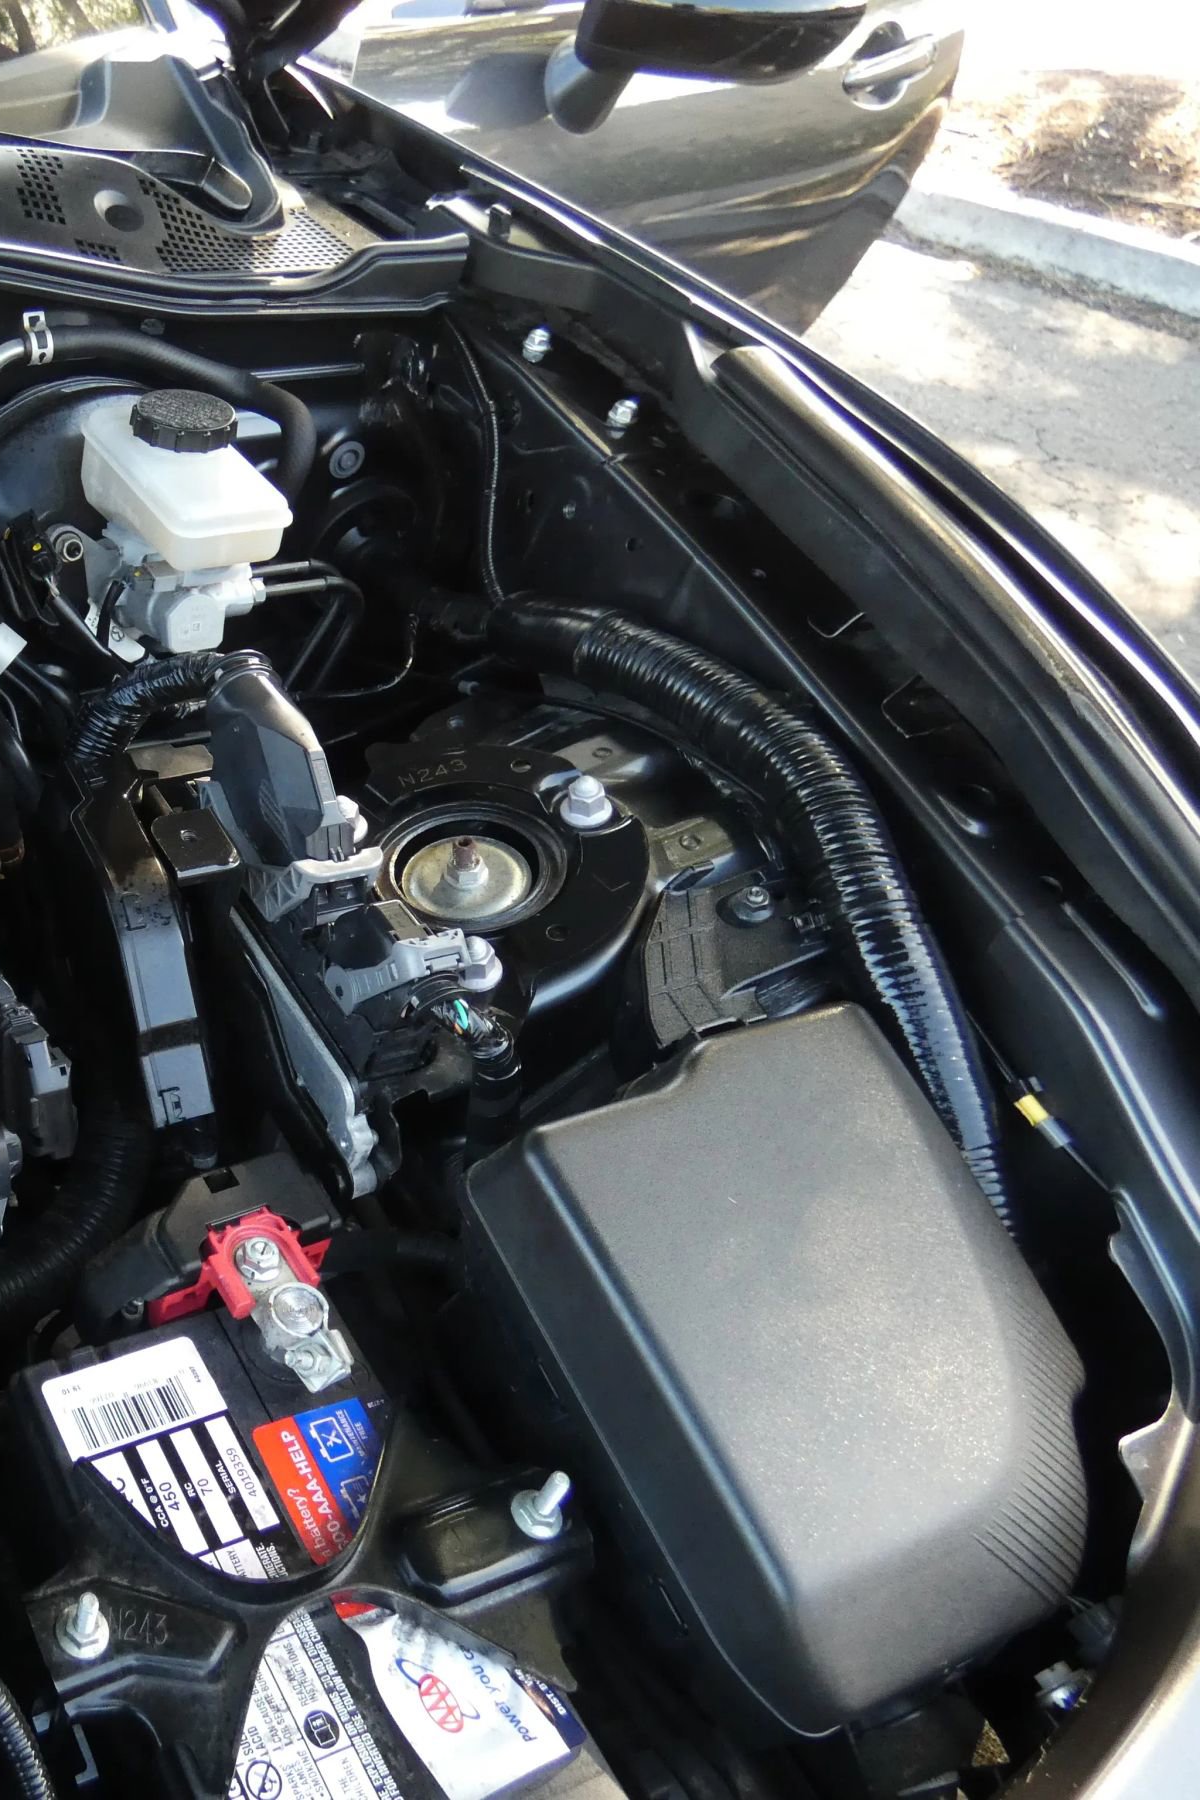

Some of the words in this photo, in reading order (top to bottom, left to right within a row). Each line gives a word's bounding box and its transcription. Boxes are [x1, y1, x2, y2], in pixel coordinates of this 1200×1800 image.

[335, 1407, 365, 1458] MAINTENANCE
[354, 1420, 368, 1440] FREE
[196, 1476, 213, 1496] 70
[214, 1459, 236, 1494] SERIAL
[225, 1444, 259, 1499] 4019359
[157, 1479, 183, 1514] 450
[183, 1481, 196, 1497] RC
[153, 1505, 170, 1528] CCA
[285, 1483, 328, 1549] battery?
[281, 1639, 319, 1703] INSTRUCTIONS.
[310, 1655, 326, 1675] NOT
[314, 1640, 338, 1676] PROPER
[332, 1675, 356, 1711] FOLLOW
[471, 1664, 501, 1695] you
[253, 1694, 274, 1725] CAUSE
[544, 1688, 567, 1716] DIST.
[245, 1724, 265, 1751] ACID
[267, 1723, 283, 1743] CAN
[343, 1720, 358, 1736] OR
[351, 1735, 383, 1786] EXPLOSION
[360, 1731, 389, 1776] INVERTED
[382, 1775, 399, 1795] FOR
